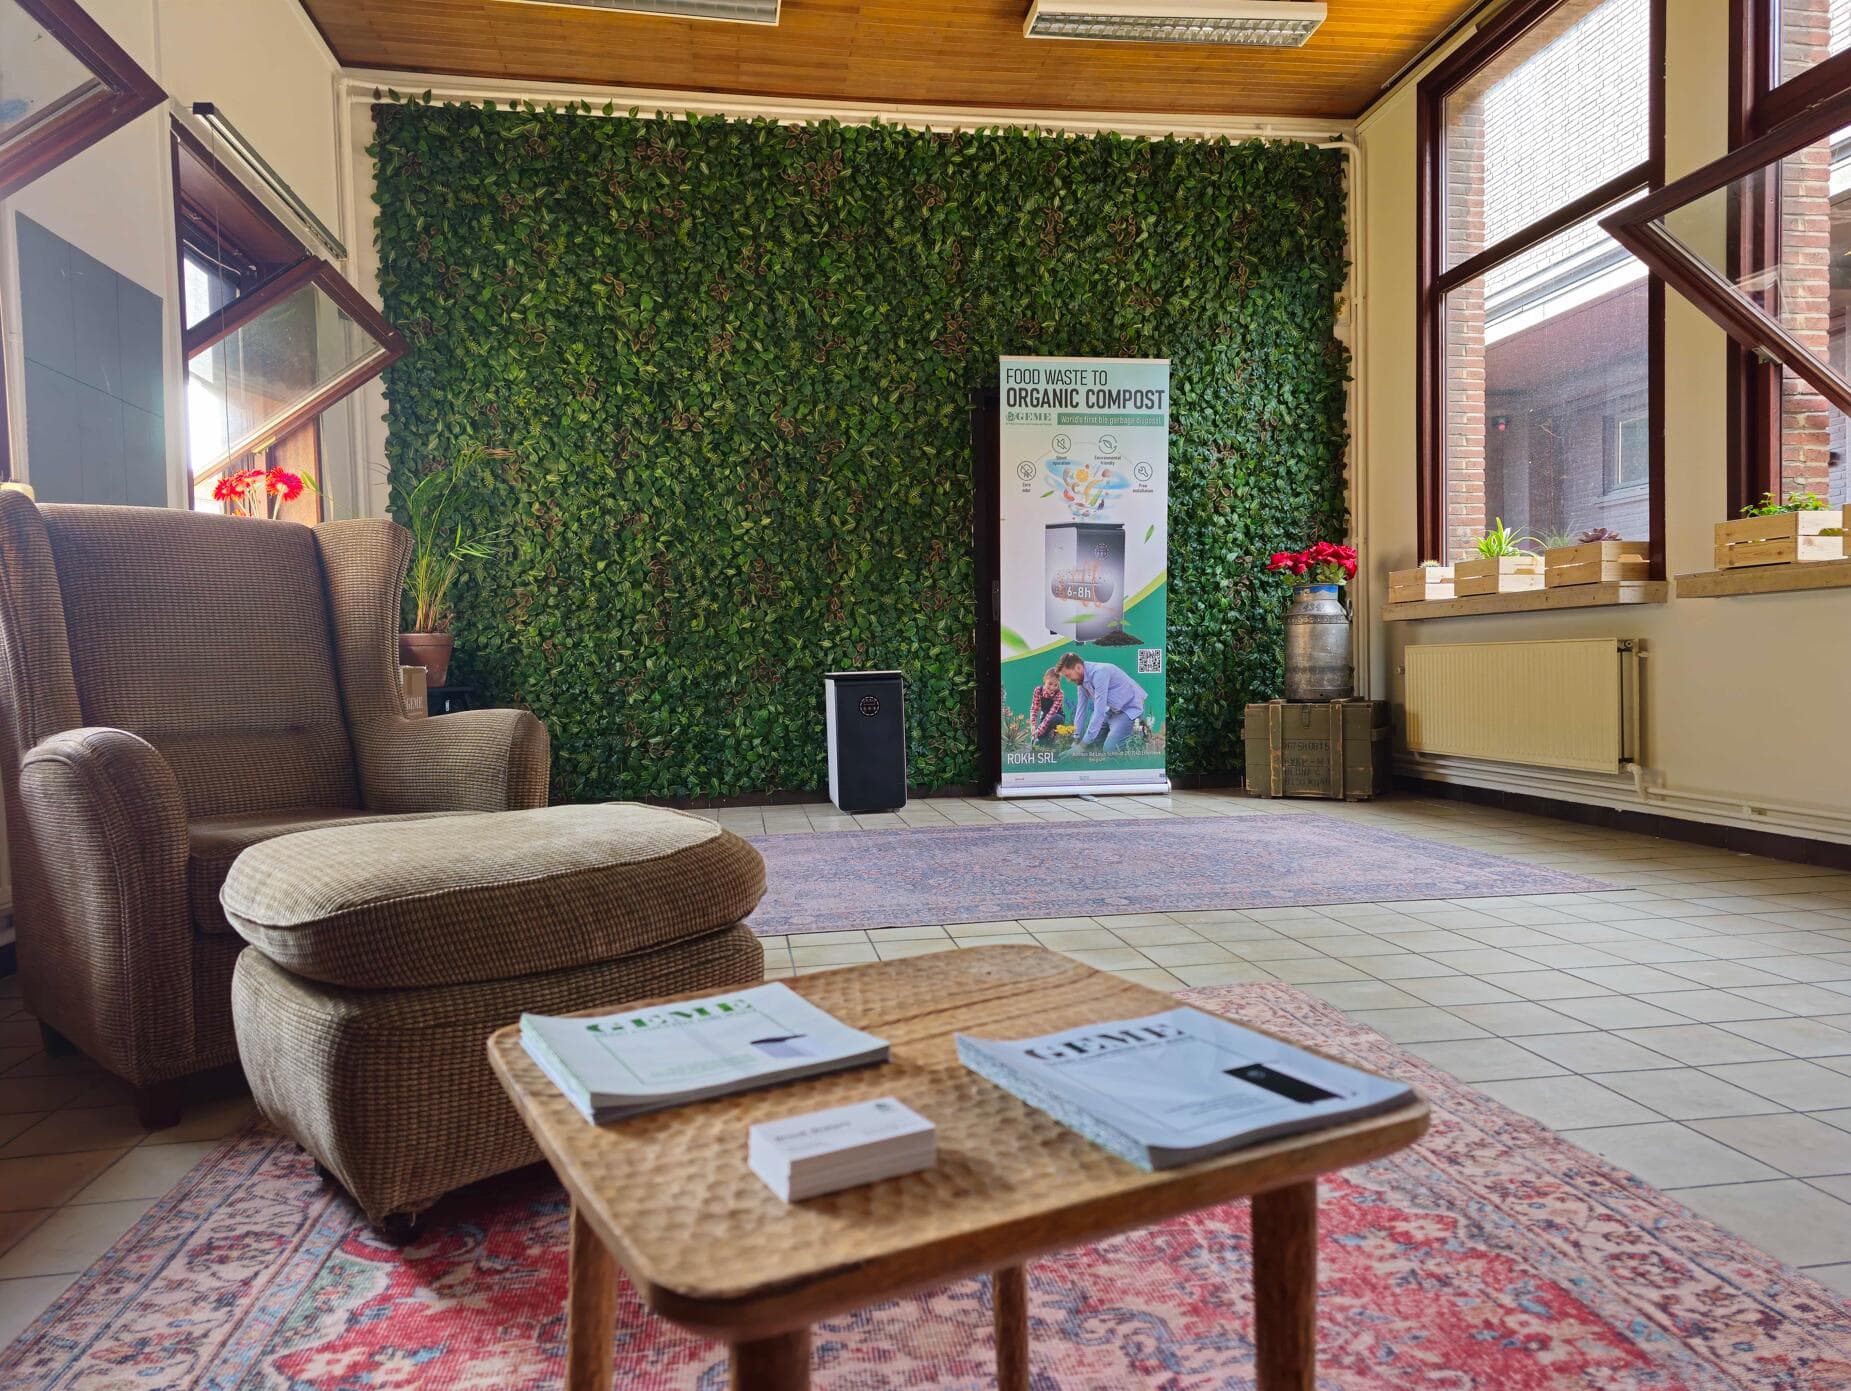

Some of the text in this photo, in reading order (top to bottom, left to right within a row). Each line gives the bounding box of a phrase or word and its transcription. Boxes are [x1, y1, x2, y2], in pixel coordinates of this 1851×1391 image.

[1006, 368, 1108, 386] FOOD WASTE TO
[1006, 387, 1165, 410] ORGANIC COMPOST
[1015, 412, 1051, 421] GEME
[1067, 586, 1091, 599] 6-8h
[1007, 752, 1035, 765] ROKH
[1037, 751, 1057, 764] SRL
[585, 998, 753, 1034] GEME
[1024, 1023, 1184, 1060] GEME
